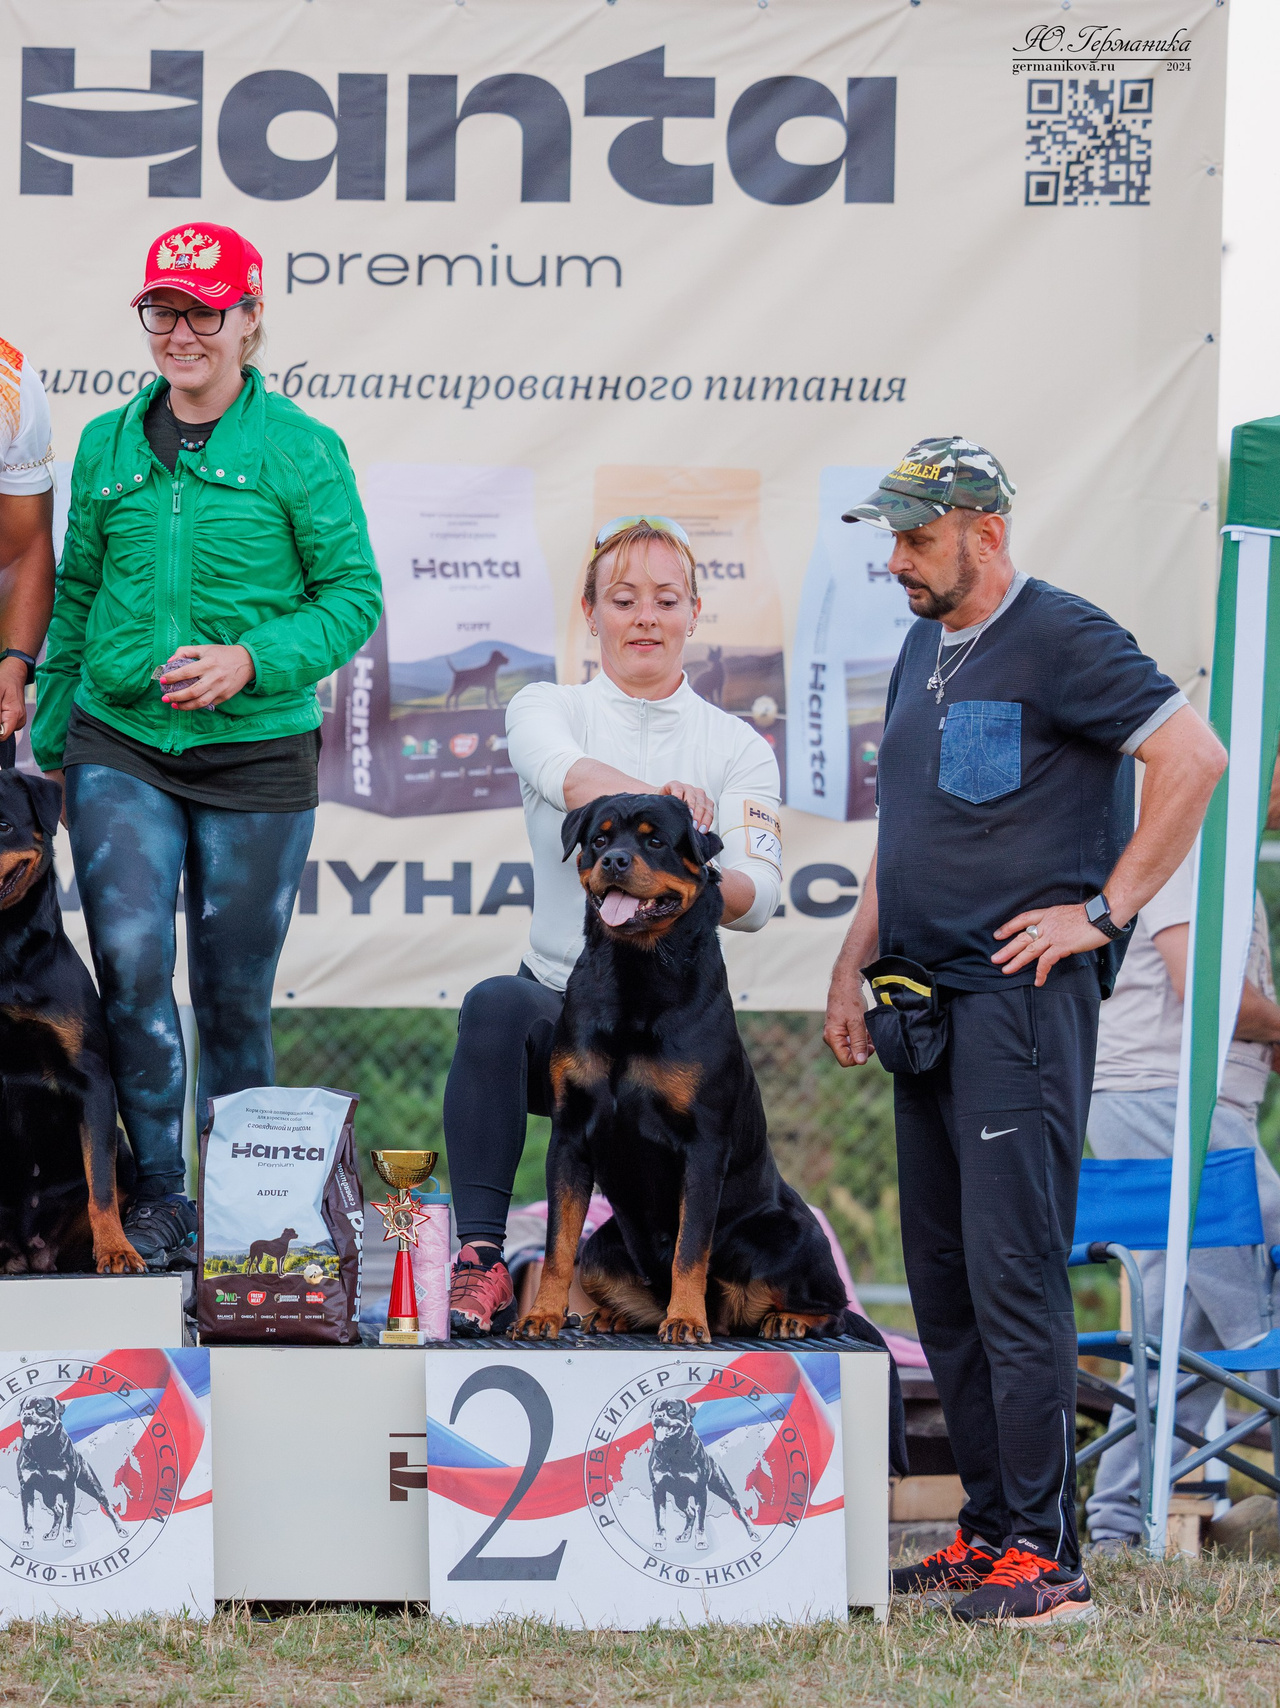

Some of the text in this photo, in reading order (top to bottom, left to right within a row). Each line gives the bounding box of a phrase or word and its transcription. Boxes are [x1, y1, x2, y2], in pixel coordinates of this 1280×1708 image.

[20, 42, 897, 205] Hanta
[287, 244, 622, 294] premium
[704, 374, 907, 404] питания
[412, 557, 521, 579] Hanta
[352, 656, 374, 797] Hanta
[809, 661, 827, 799] Hanta
[231, 1142, 325, 1162] Hanta
[257, 1189, 289, 1197] ADULT
[57, 1363, 133, 1398] КЛУБ
[137, 1402, 177, 1525] РОССИИ
[587, 1366, 809, 1531] РОТВЕЙЛЕР КЛУБ РОССИИ
[447, 1365, 568, 1581] 2
[9, 1546, 132, 1583] РКФ-НКПР
[642, 1548, 765, 1585] РКФ-НКПР
